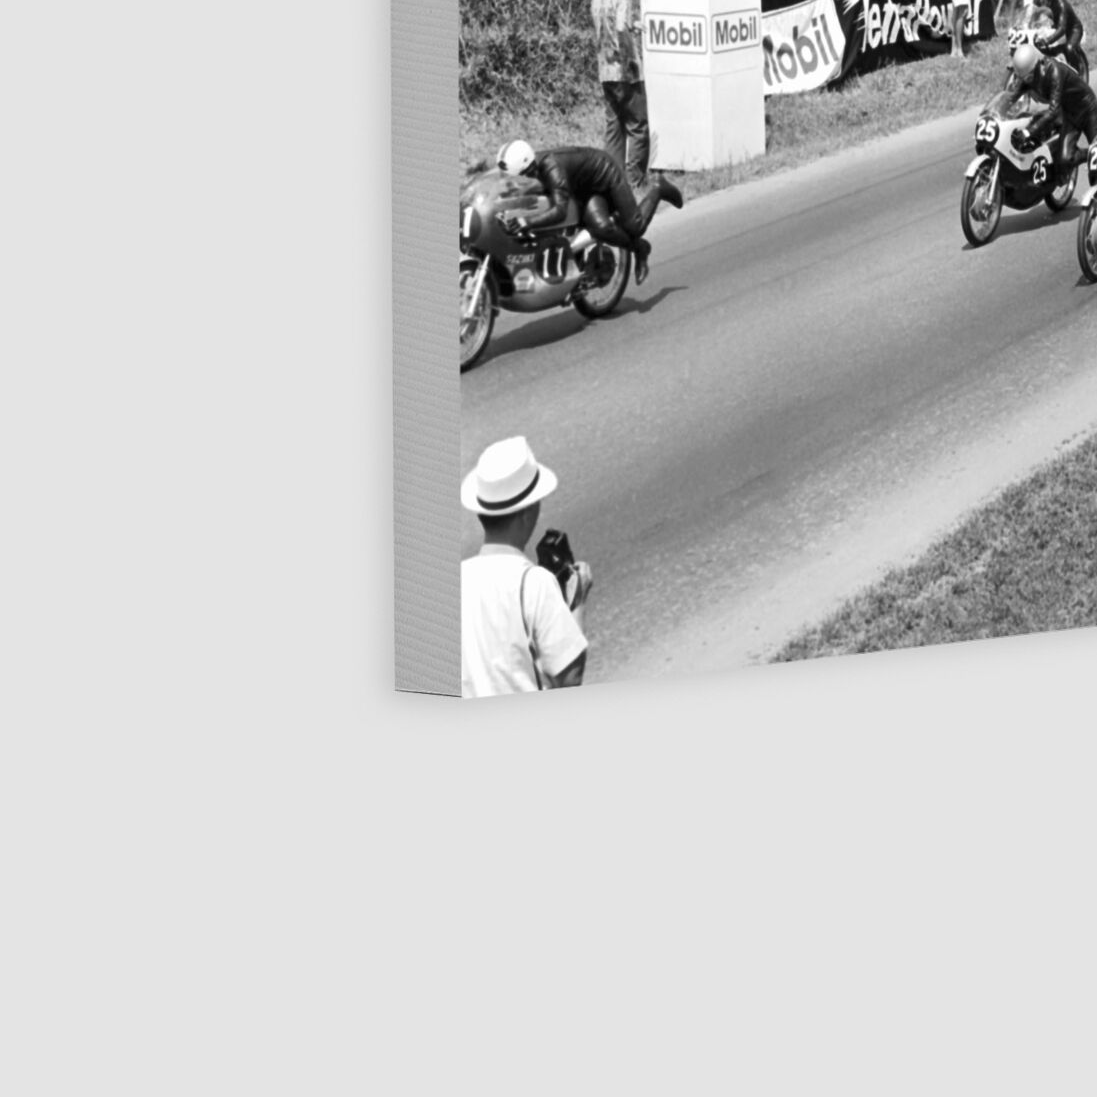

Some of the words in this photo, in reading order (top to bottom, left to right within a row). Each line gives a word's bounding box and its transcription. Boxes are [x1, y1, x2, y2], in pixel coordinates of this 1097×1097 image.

[649, 19, 702, 47] Mobil
[715, 16, 757, 46] Mobil
[1008, 30, 1026, 47] 22
[976, 118, 997, 142] 25
[1033, 158, 1047, 183] 25
[542, 247, 564, 278] 11
